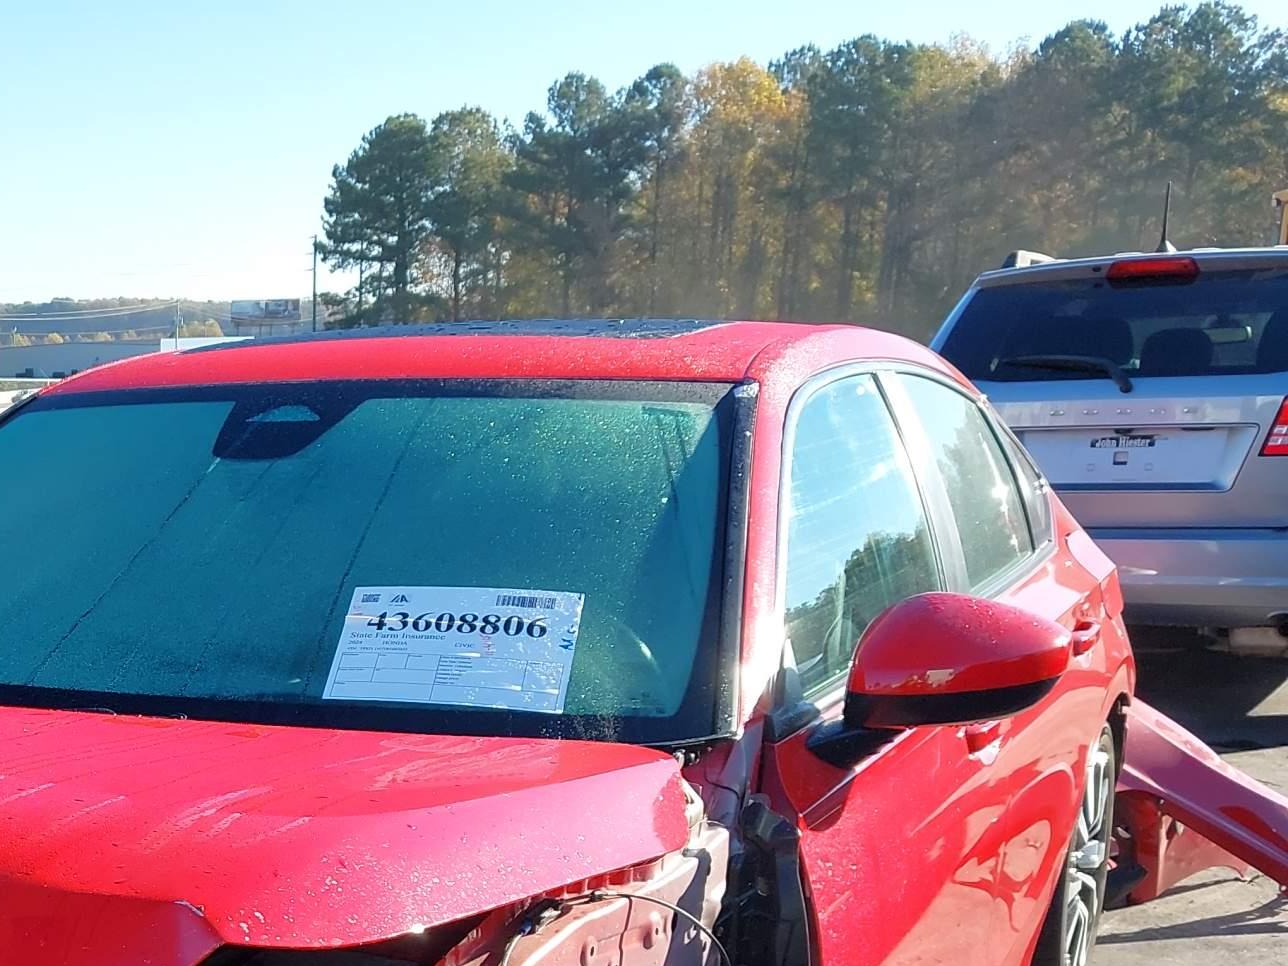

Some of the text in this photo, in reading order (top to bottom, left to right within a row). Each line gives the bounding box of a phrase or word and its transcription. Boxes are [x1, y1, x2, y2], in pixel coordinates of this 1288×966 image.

[1095, 439, 1117, 448] John
[367, 611, 549, 638] 43608806
[351, 631, 447, 641] State Farm Insurance
